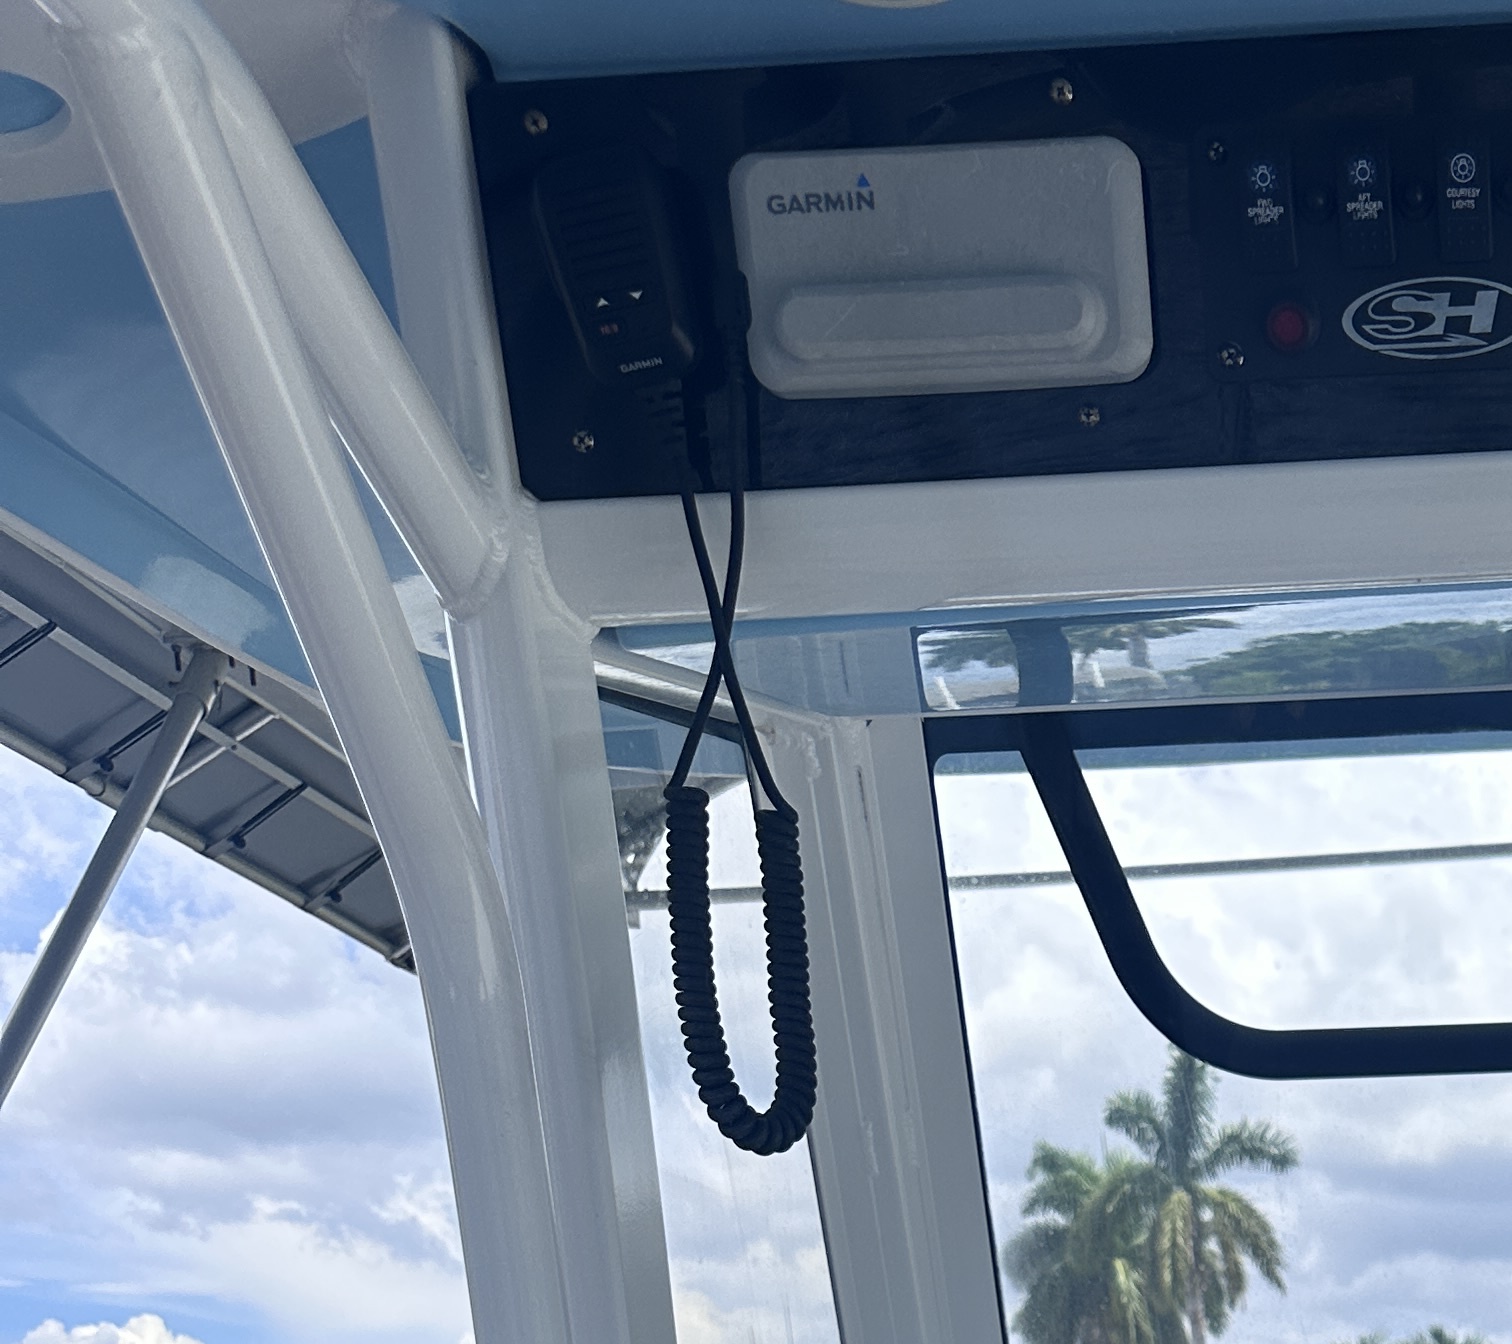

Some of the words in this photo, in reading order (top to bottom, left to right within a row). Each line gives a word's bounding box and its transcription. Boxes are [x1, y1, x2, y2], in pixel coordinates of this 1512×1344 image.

[1357, 192, 1372, 202] AFT
[1446, 187, 1481, 198] COURTESY
[767, 190, 875, 215] GARMIN
[1346, 201, 1383, 212] SPREADER
[1451, 199, 1476, 210] LIGHTS
[1247, 206, 1284, 218] SPREADER
[1361, 290, 1500, 341] SH
[619, 356, 663, 374] GARMIN
